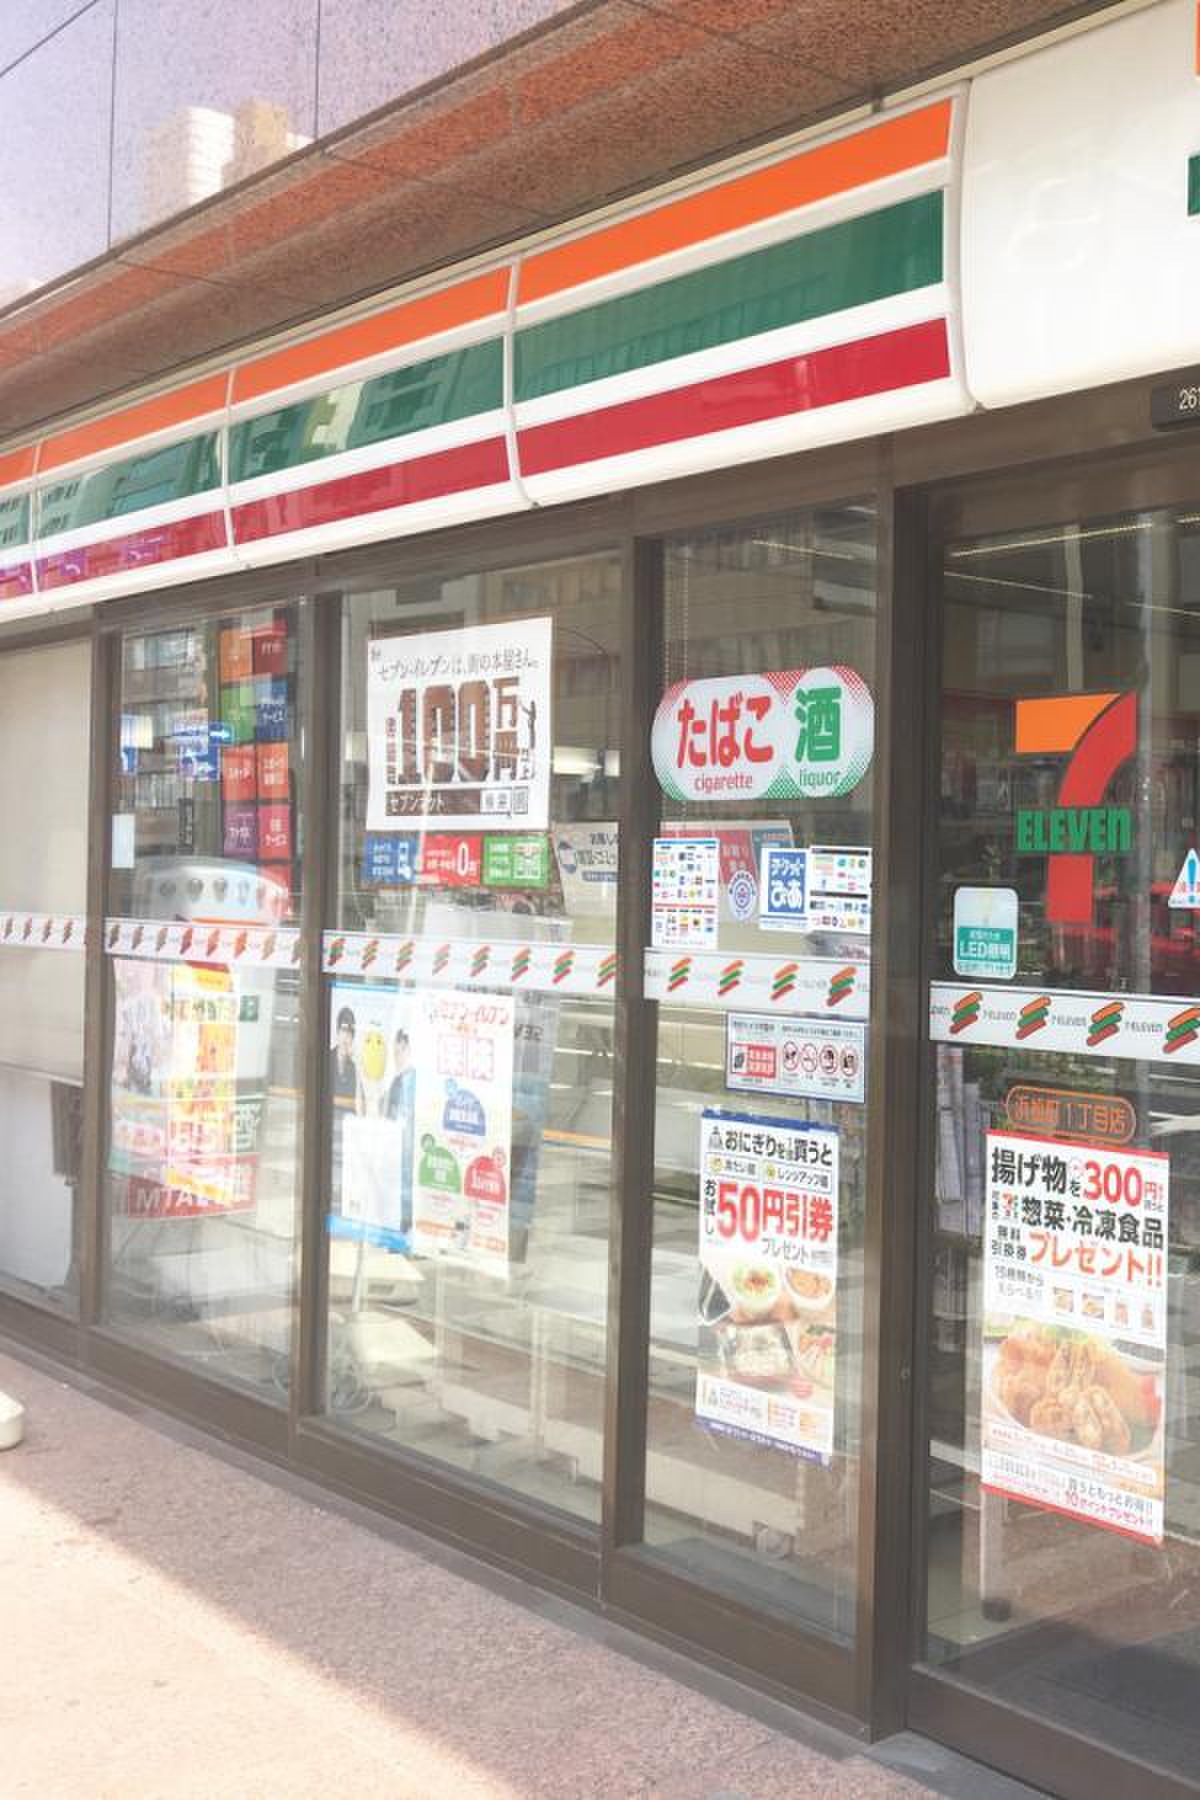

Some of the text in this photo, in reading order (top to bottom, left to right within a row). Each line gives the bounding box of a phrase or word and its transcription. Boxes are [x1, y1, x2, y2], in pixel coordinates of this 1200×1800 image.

[677, 691, 774, 768] たばこ
[794, 687, 842, 763] 酒
[694, 774, 753, 793] cigarette
[800, 769, 841, 788] liquor
[717, 1182, 833, 1244] 50円引券
[1021, 1197, 1164, 1250] 惣菜・冷凍食品
